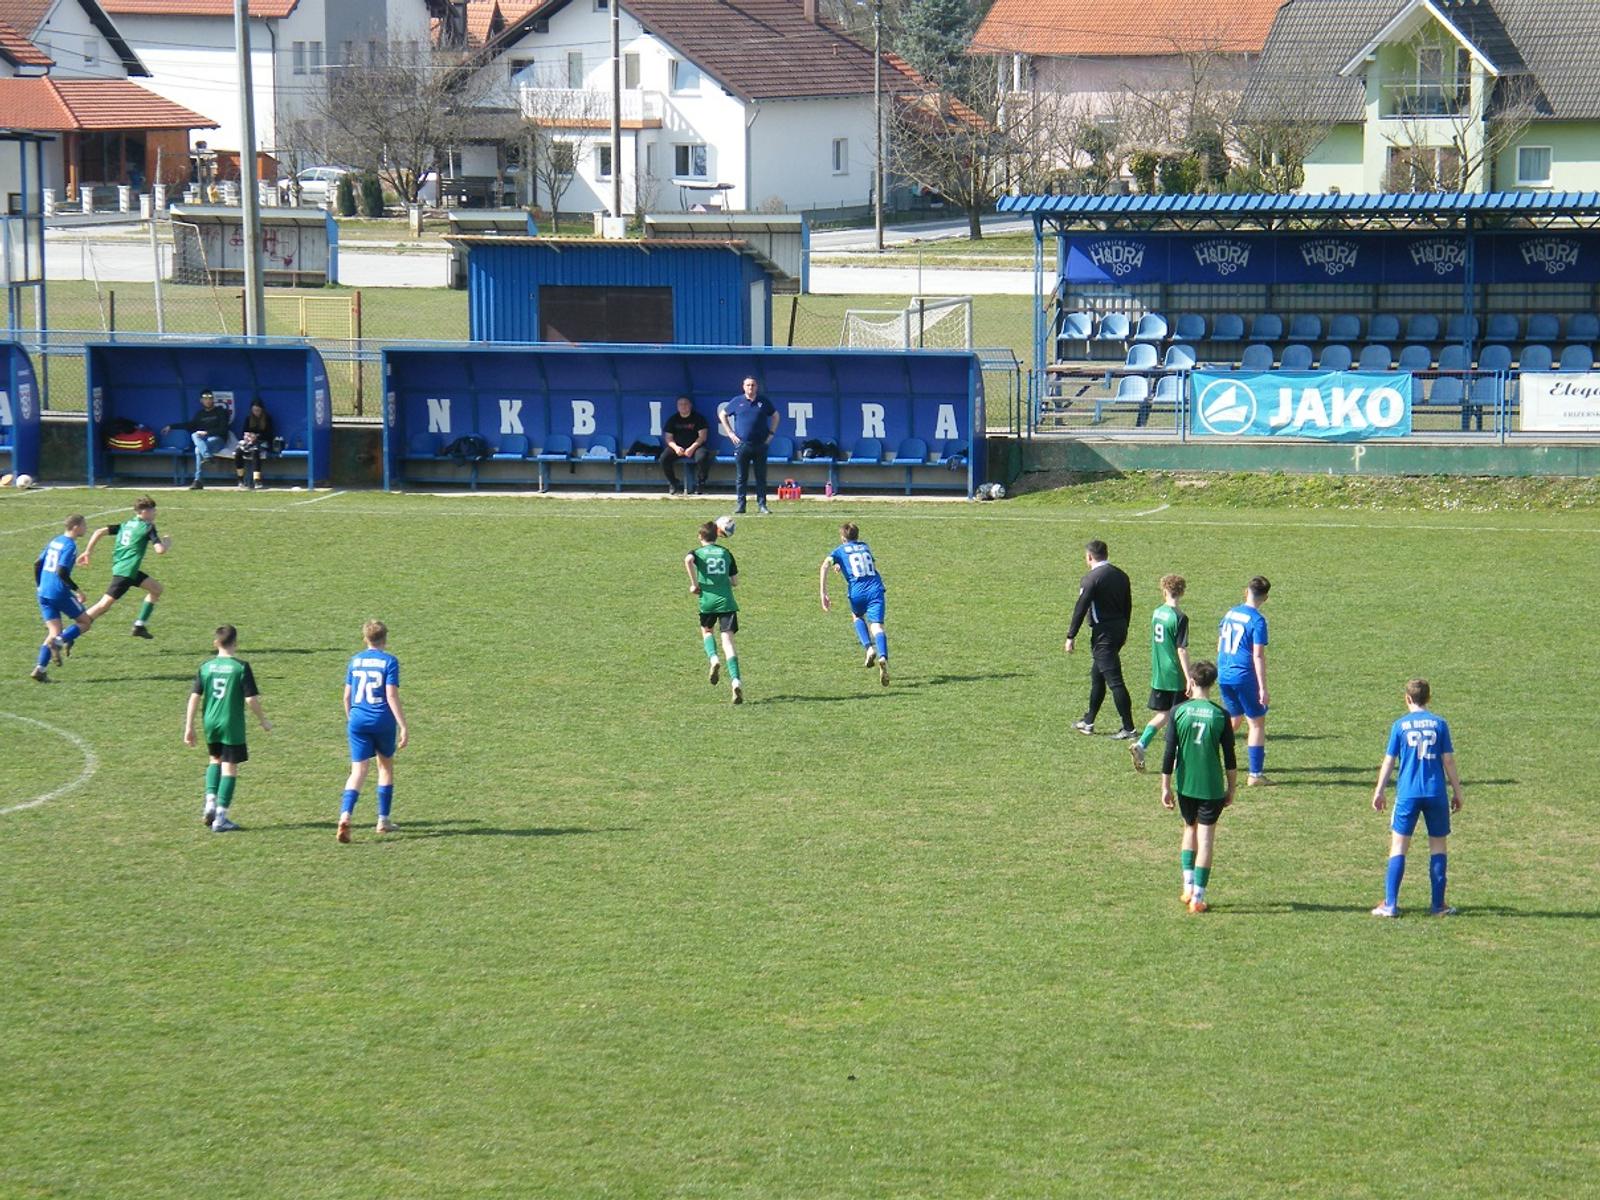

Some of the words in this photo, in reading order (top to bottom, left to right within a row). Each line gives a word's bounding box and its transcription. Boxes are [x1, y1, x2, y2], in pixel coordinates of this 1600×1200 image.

[1269, 387, 1404, 428] JAKO
[706, 558, 726, 574] 23
[849, 552, 876, 577] 88
[1154, 623, 1165, 643] 9
[212, 678, 226, 699] 5
[352, 670, 383, 704] 72
[1191, 721, 1206, 745] 7
[1406, 730, 1437, 760] 92
